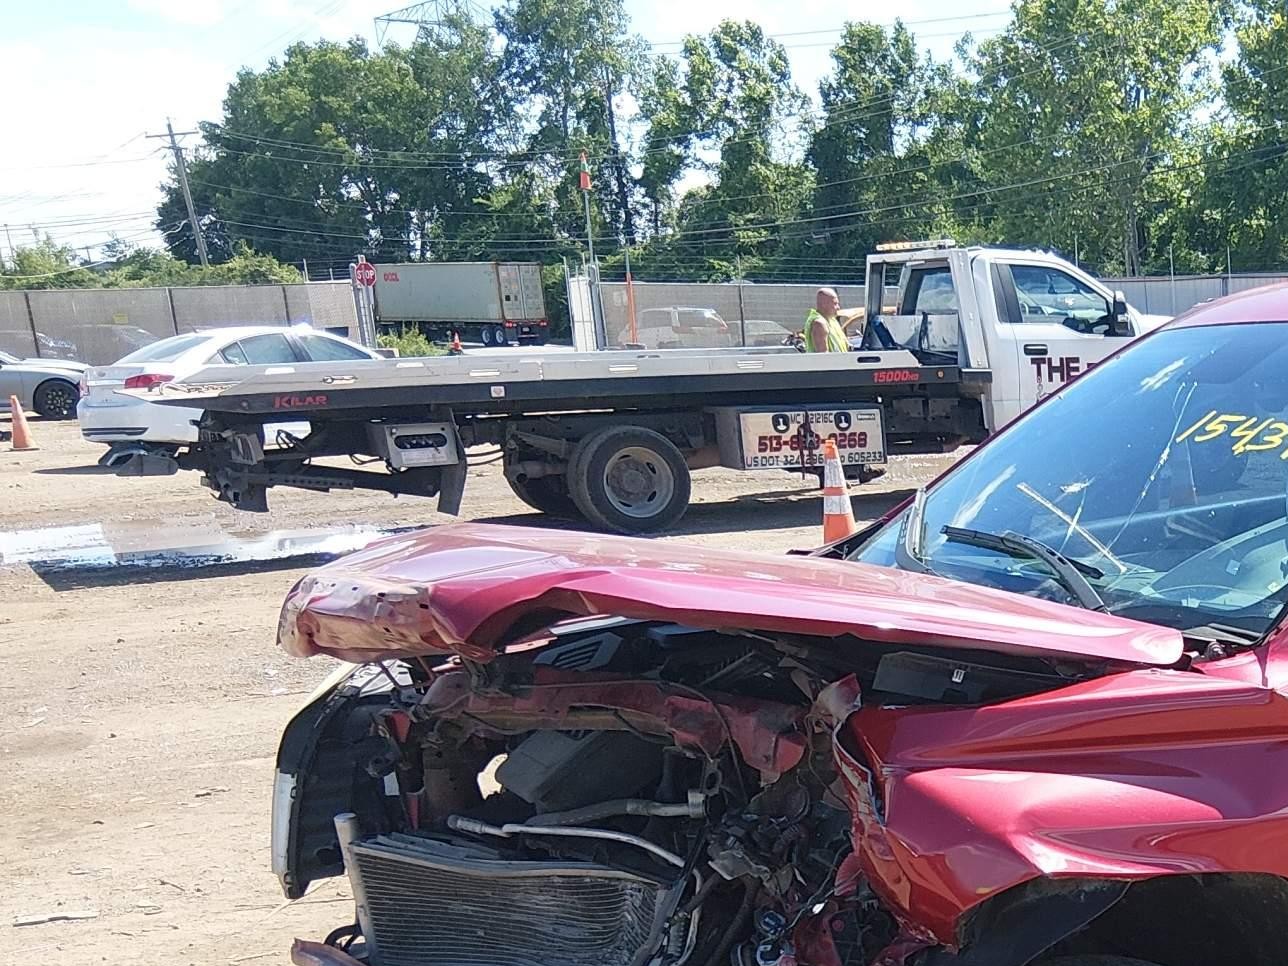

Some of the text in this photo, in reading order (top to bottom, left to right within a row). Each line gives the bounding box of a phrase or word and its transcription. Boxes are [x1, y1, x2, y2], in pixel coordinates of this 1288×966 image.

[357, 270, 375, 280] STOP
[1030, 357, 1081, 384] THE
[273, 394, 328, 409] KILAR
